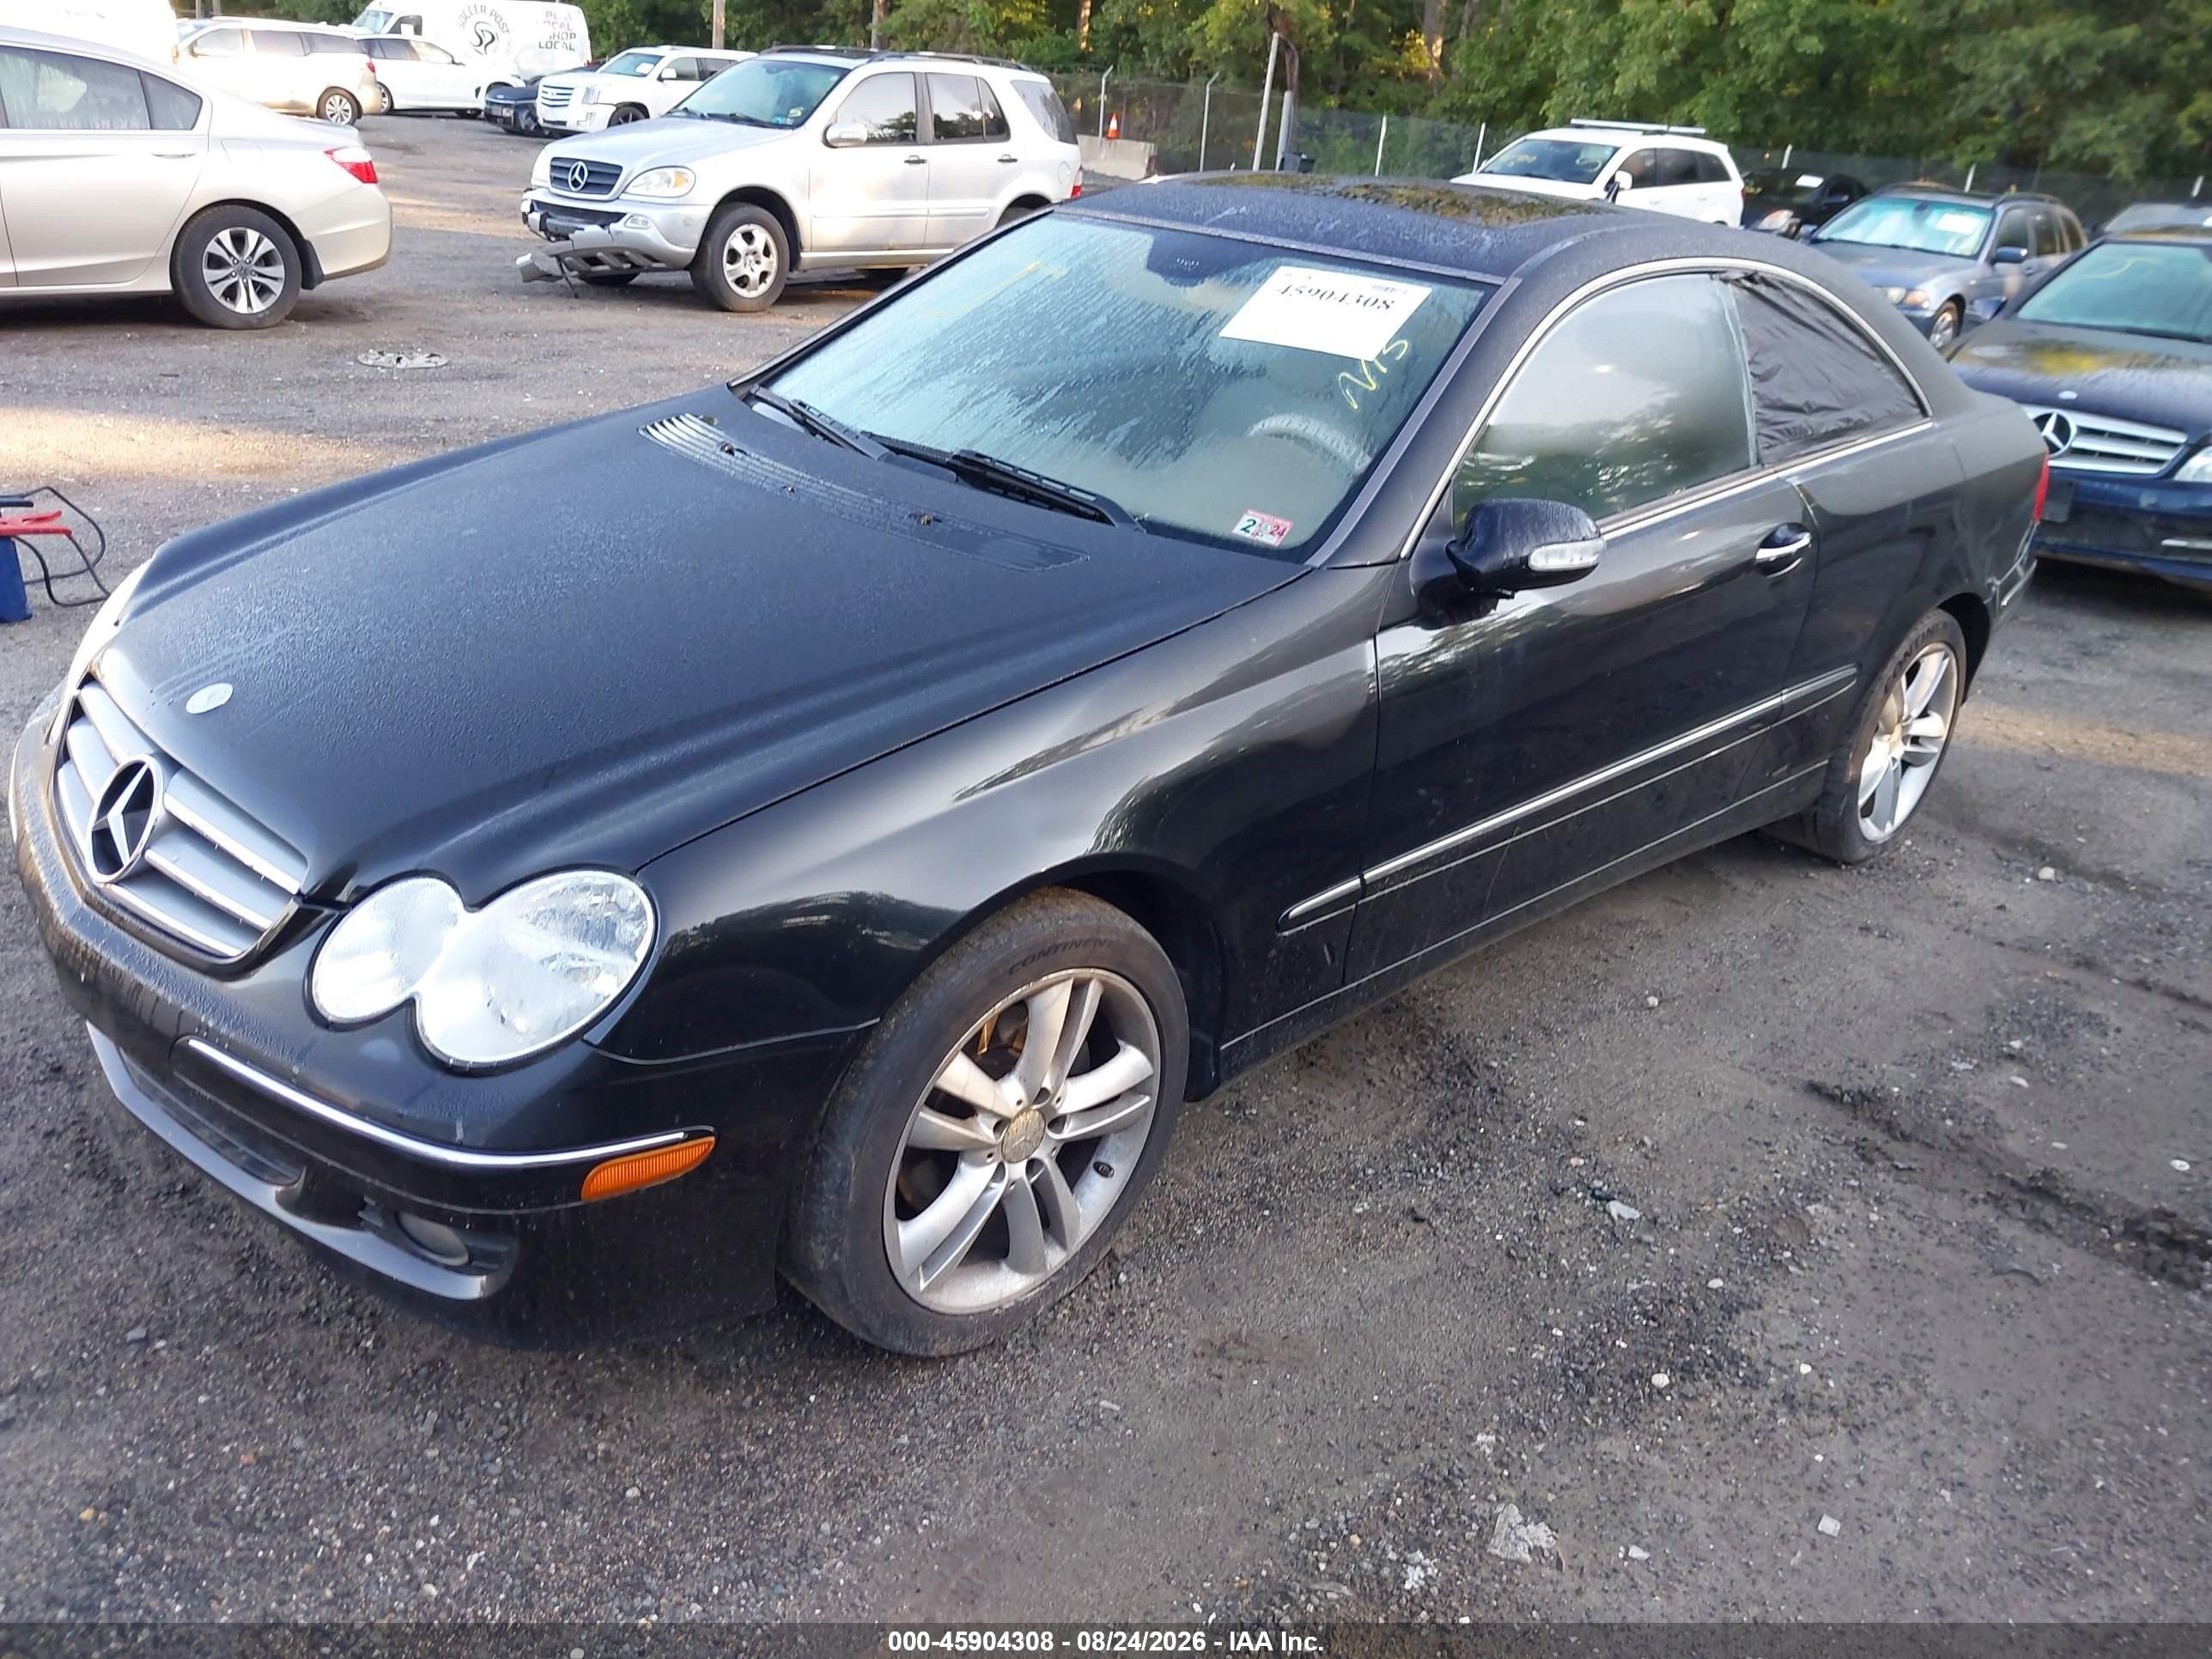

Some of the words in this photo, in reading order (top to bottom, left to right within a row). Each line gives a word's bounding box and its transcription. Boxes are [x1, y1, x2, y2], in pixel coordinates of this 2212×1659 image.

[545, 10, 572, 21] PL
[489, 9, 510, 34] POST
[538, 20, 574, 32] OCAL
[549, 31, 576, 40] HOP
[538, 40, 575, 51] LOCAL
[1240, 518, 1256, 533] 2
